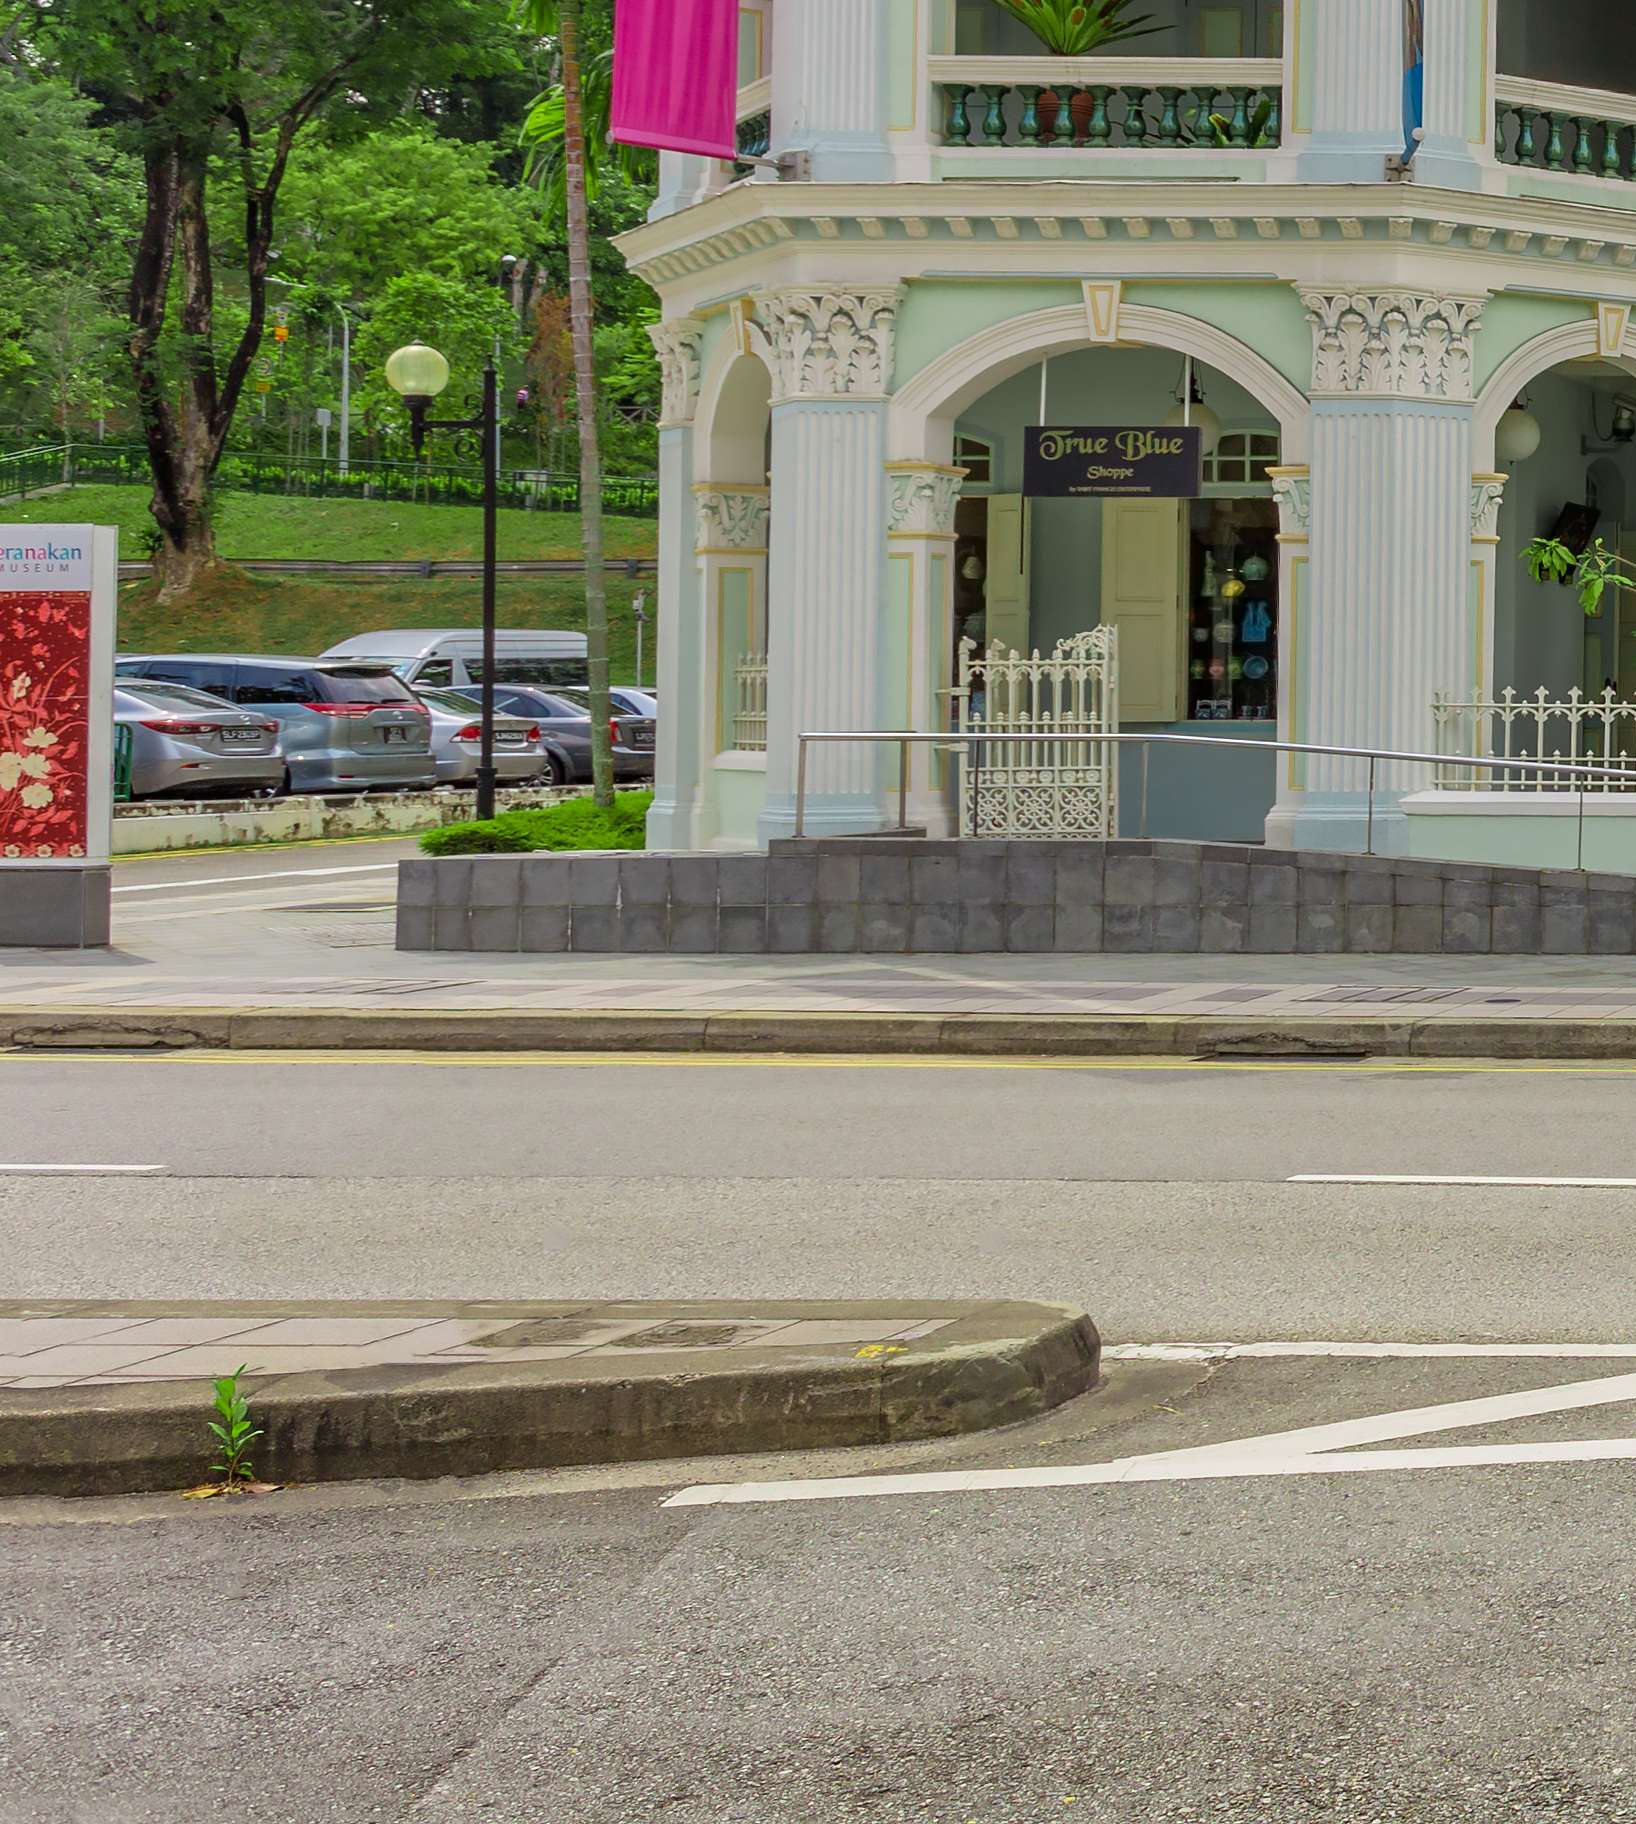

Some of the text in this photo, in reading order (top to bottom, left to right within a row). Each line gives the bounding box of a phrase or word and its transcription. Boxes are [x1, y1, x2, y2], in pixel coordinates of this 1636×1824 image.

[1040, 430, 1184, 461] True Blue
[1087, 465, 1135, 480] Shoppe
